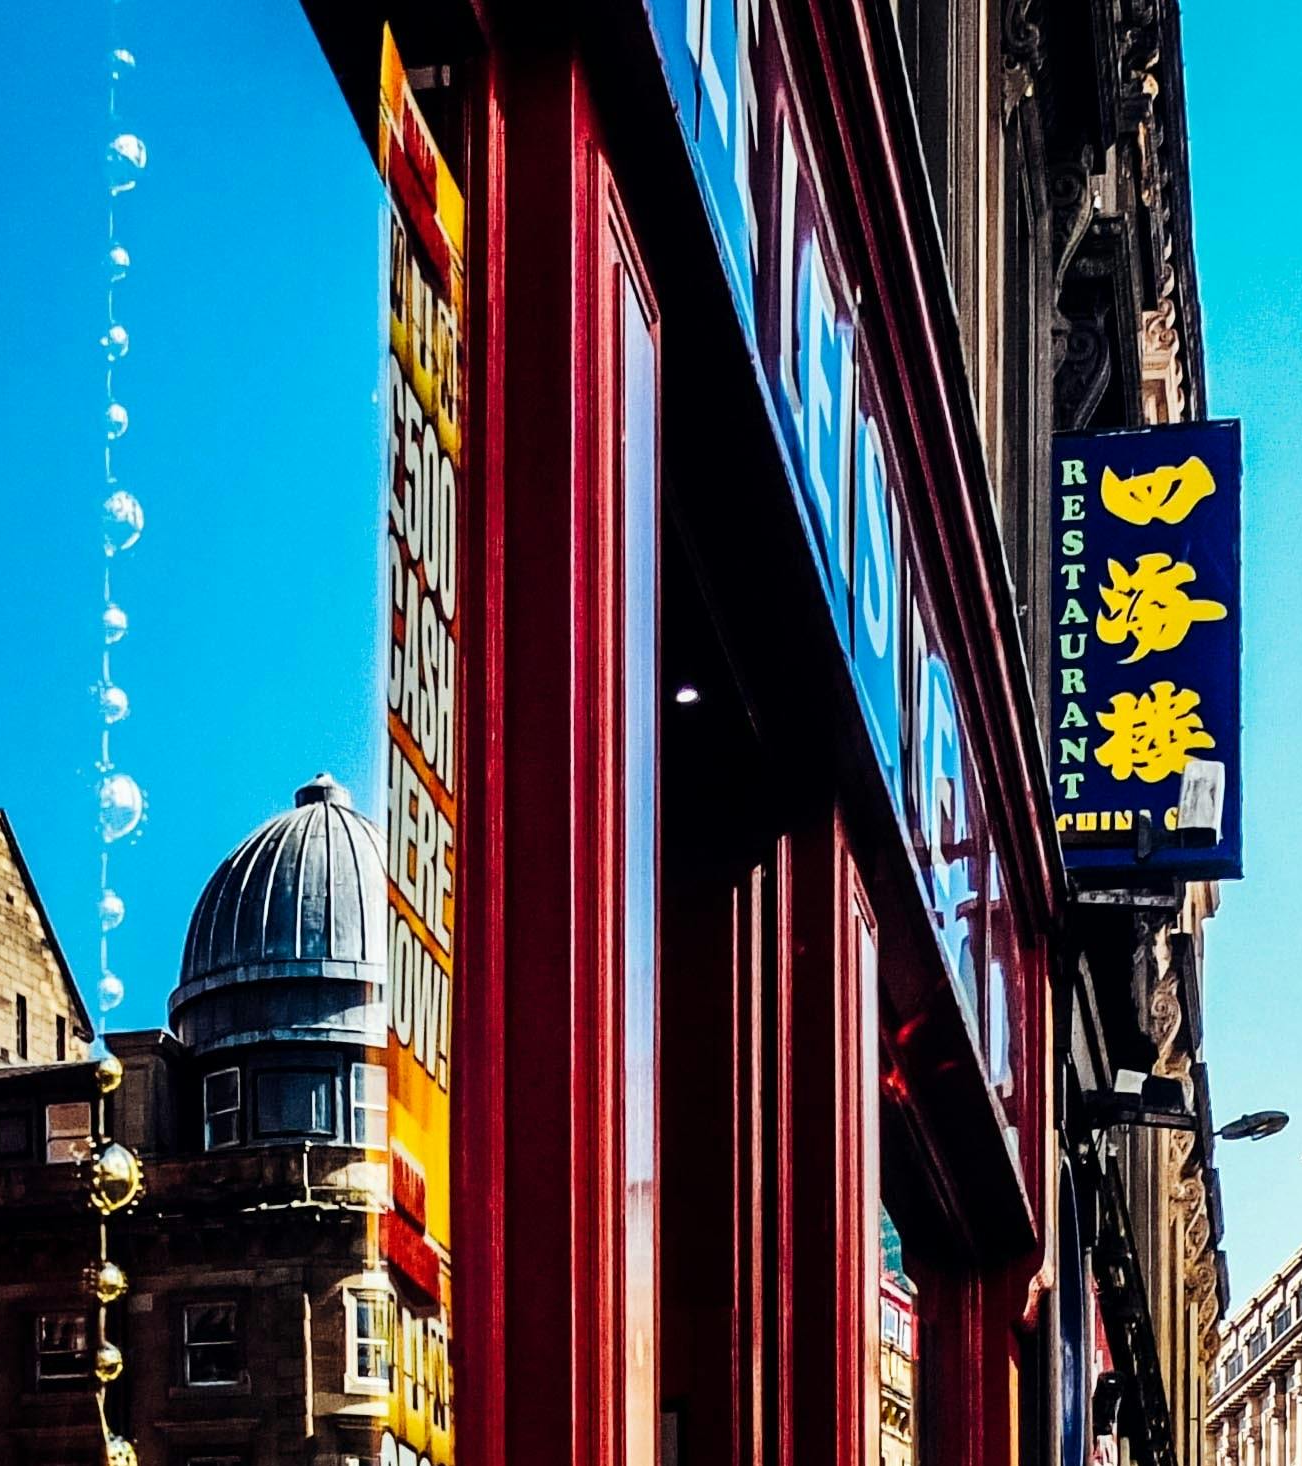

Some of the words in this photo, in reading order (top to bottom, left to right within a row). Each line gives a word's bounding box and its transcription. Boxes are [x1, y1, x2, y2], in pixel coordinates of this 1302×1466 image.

[388, 352, 456, 622] £500
[387, 530, 457, 794] CASH
[1058, 459, 1089, 800] RESTAURANT
[387, 736, 455, 957] HERE
[1055, 808, 1153, 833] CHIN
